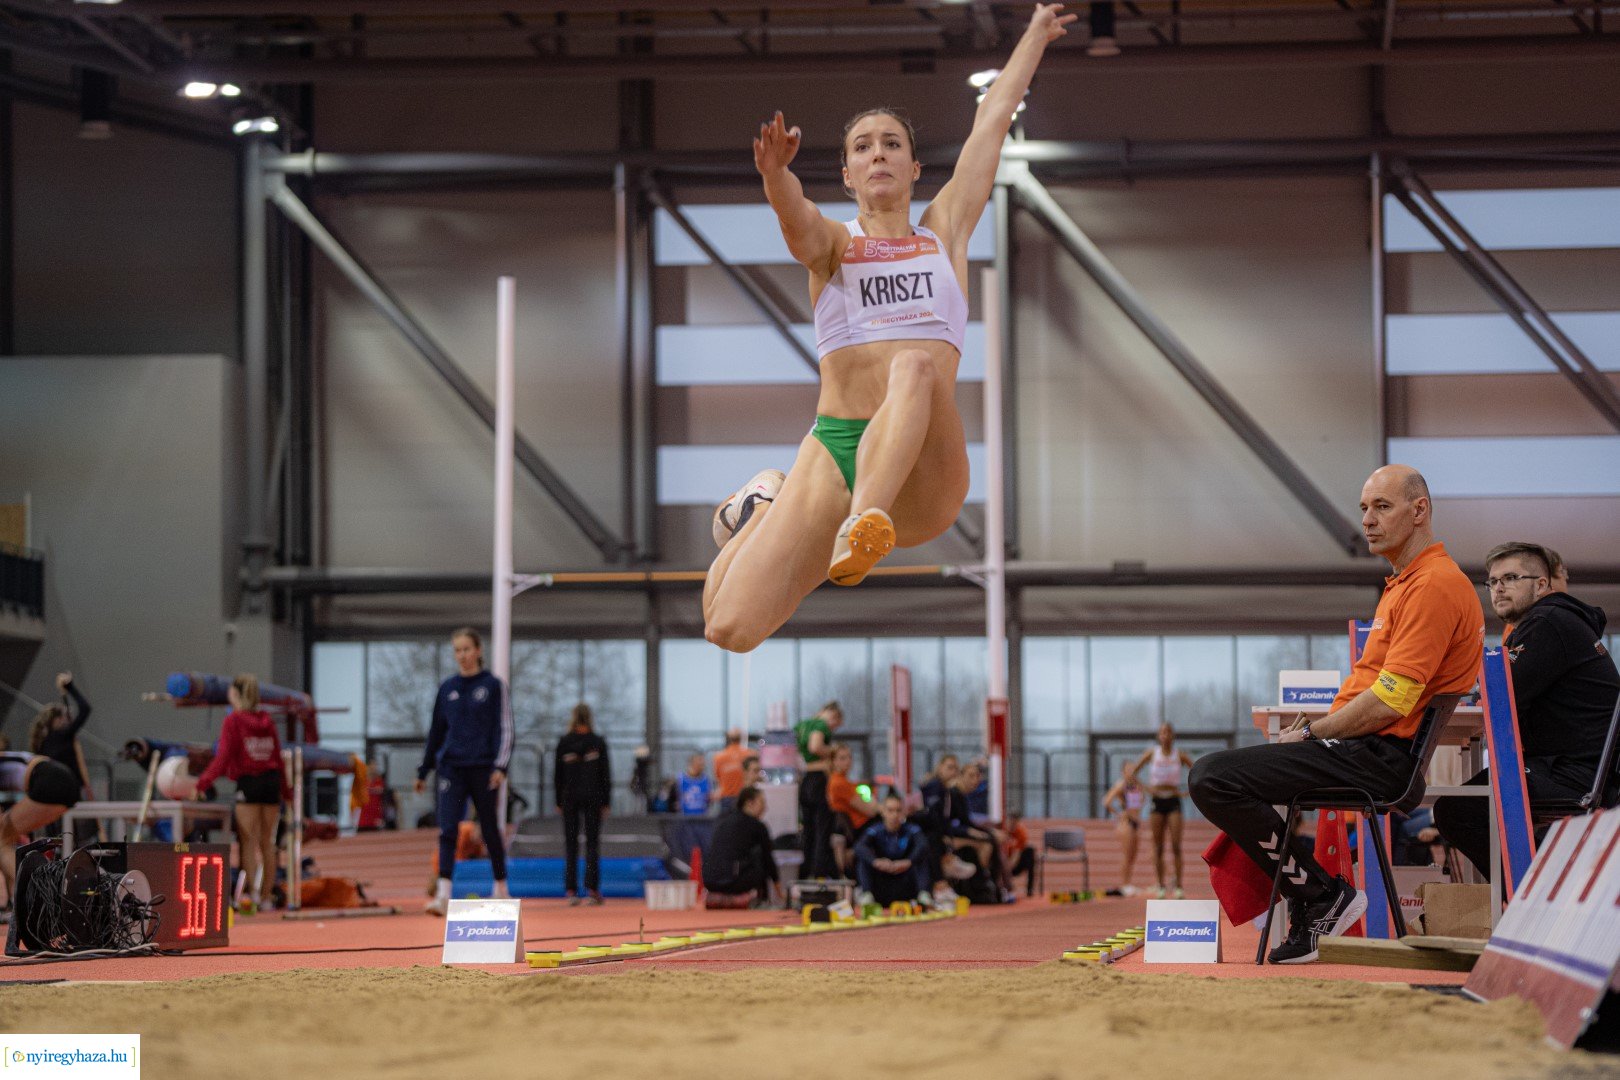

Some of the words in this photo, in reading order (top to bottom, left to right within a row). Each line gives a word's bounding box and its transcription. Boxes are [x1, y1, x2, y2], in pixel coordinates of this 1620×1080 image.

[860, 271, 934, 307] KRISZT
[1300, 691, 1337, 701] polanik
[467, 926, 511, 937] polanik
[1167, 926, 1212, 937] polanik
